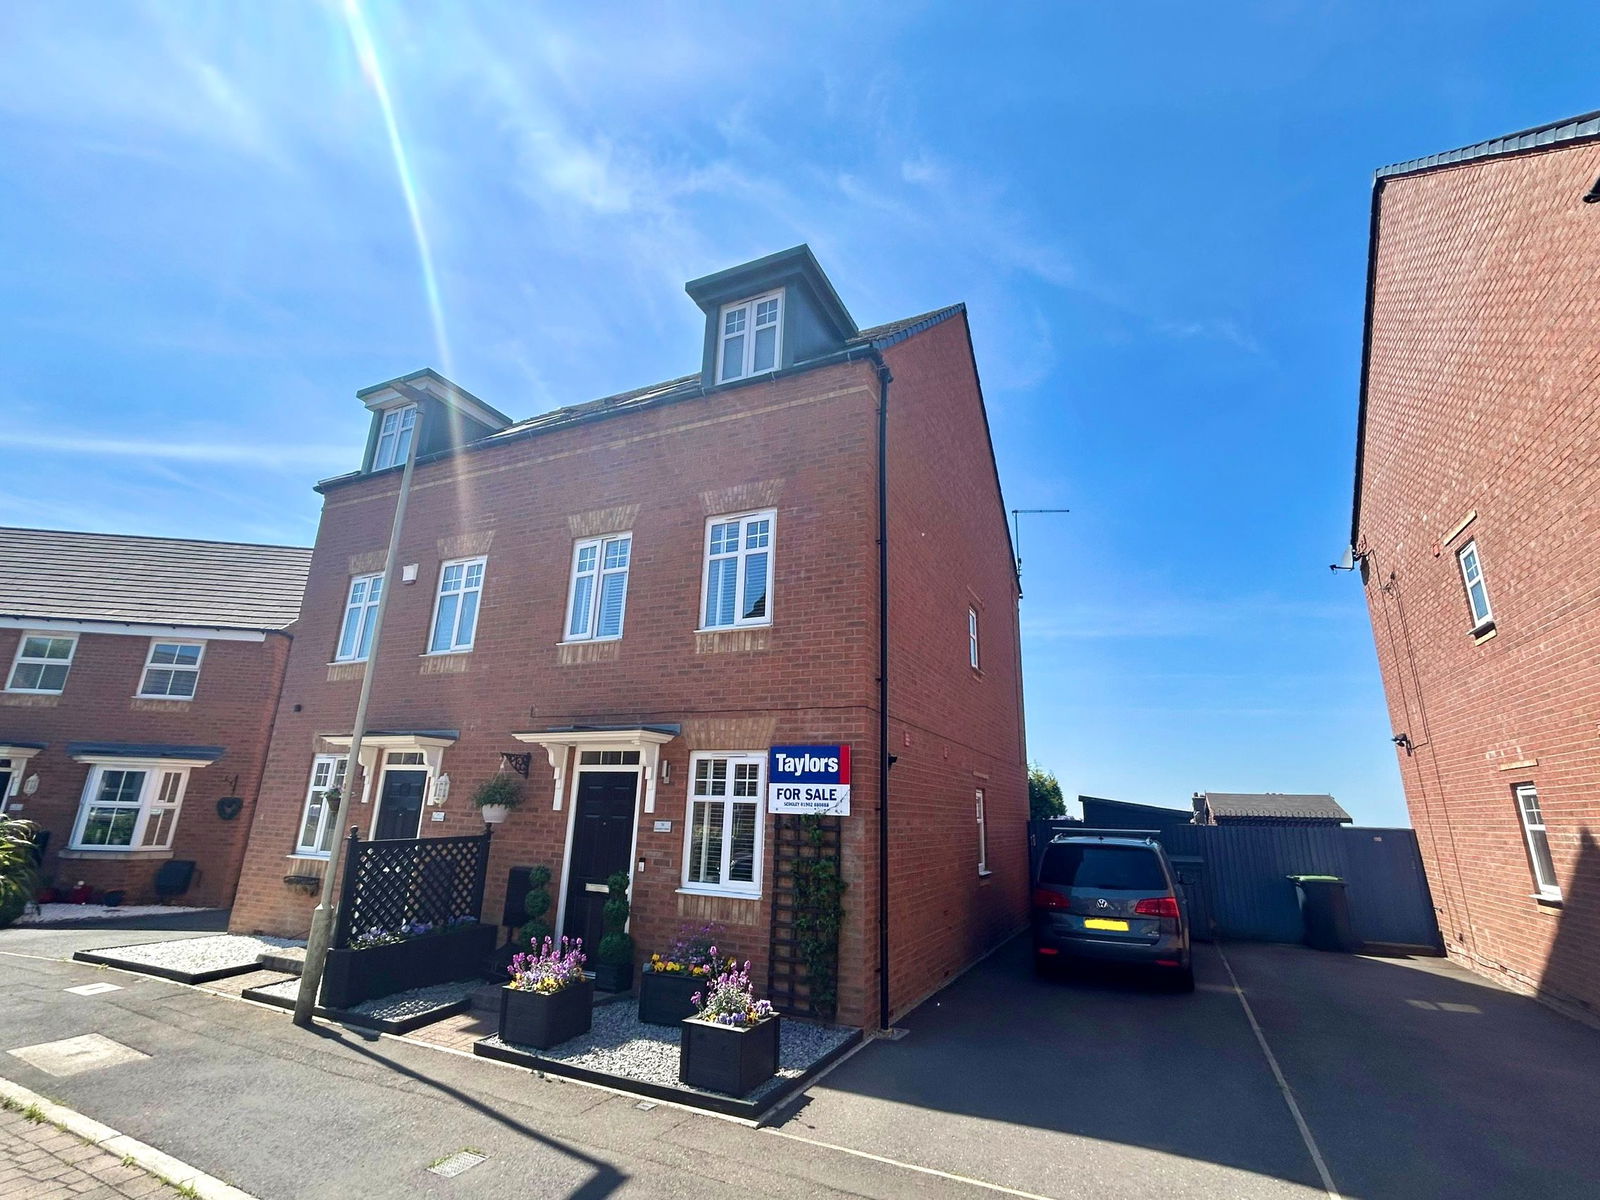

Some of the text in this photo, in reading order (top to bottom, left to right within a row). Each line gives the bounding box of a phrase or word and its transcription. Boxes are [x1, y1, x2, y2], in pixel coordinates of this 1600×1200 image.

[775, 753, 839, 777] Taylors
[776, 788, 837, 801] FOR SALE
